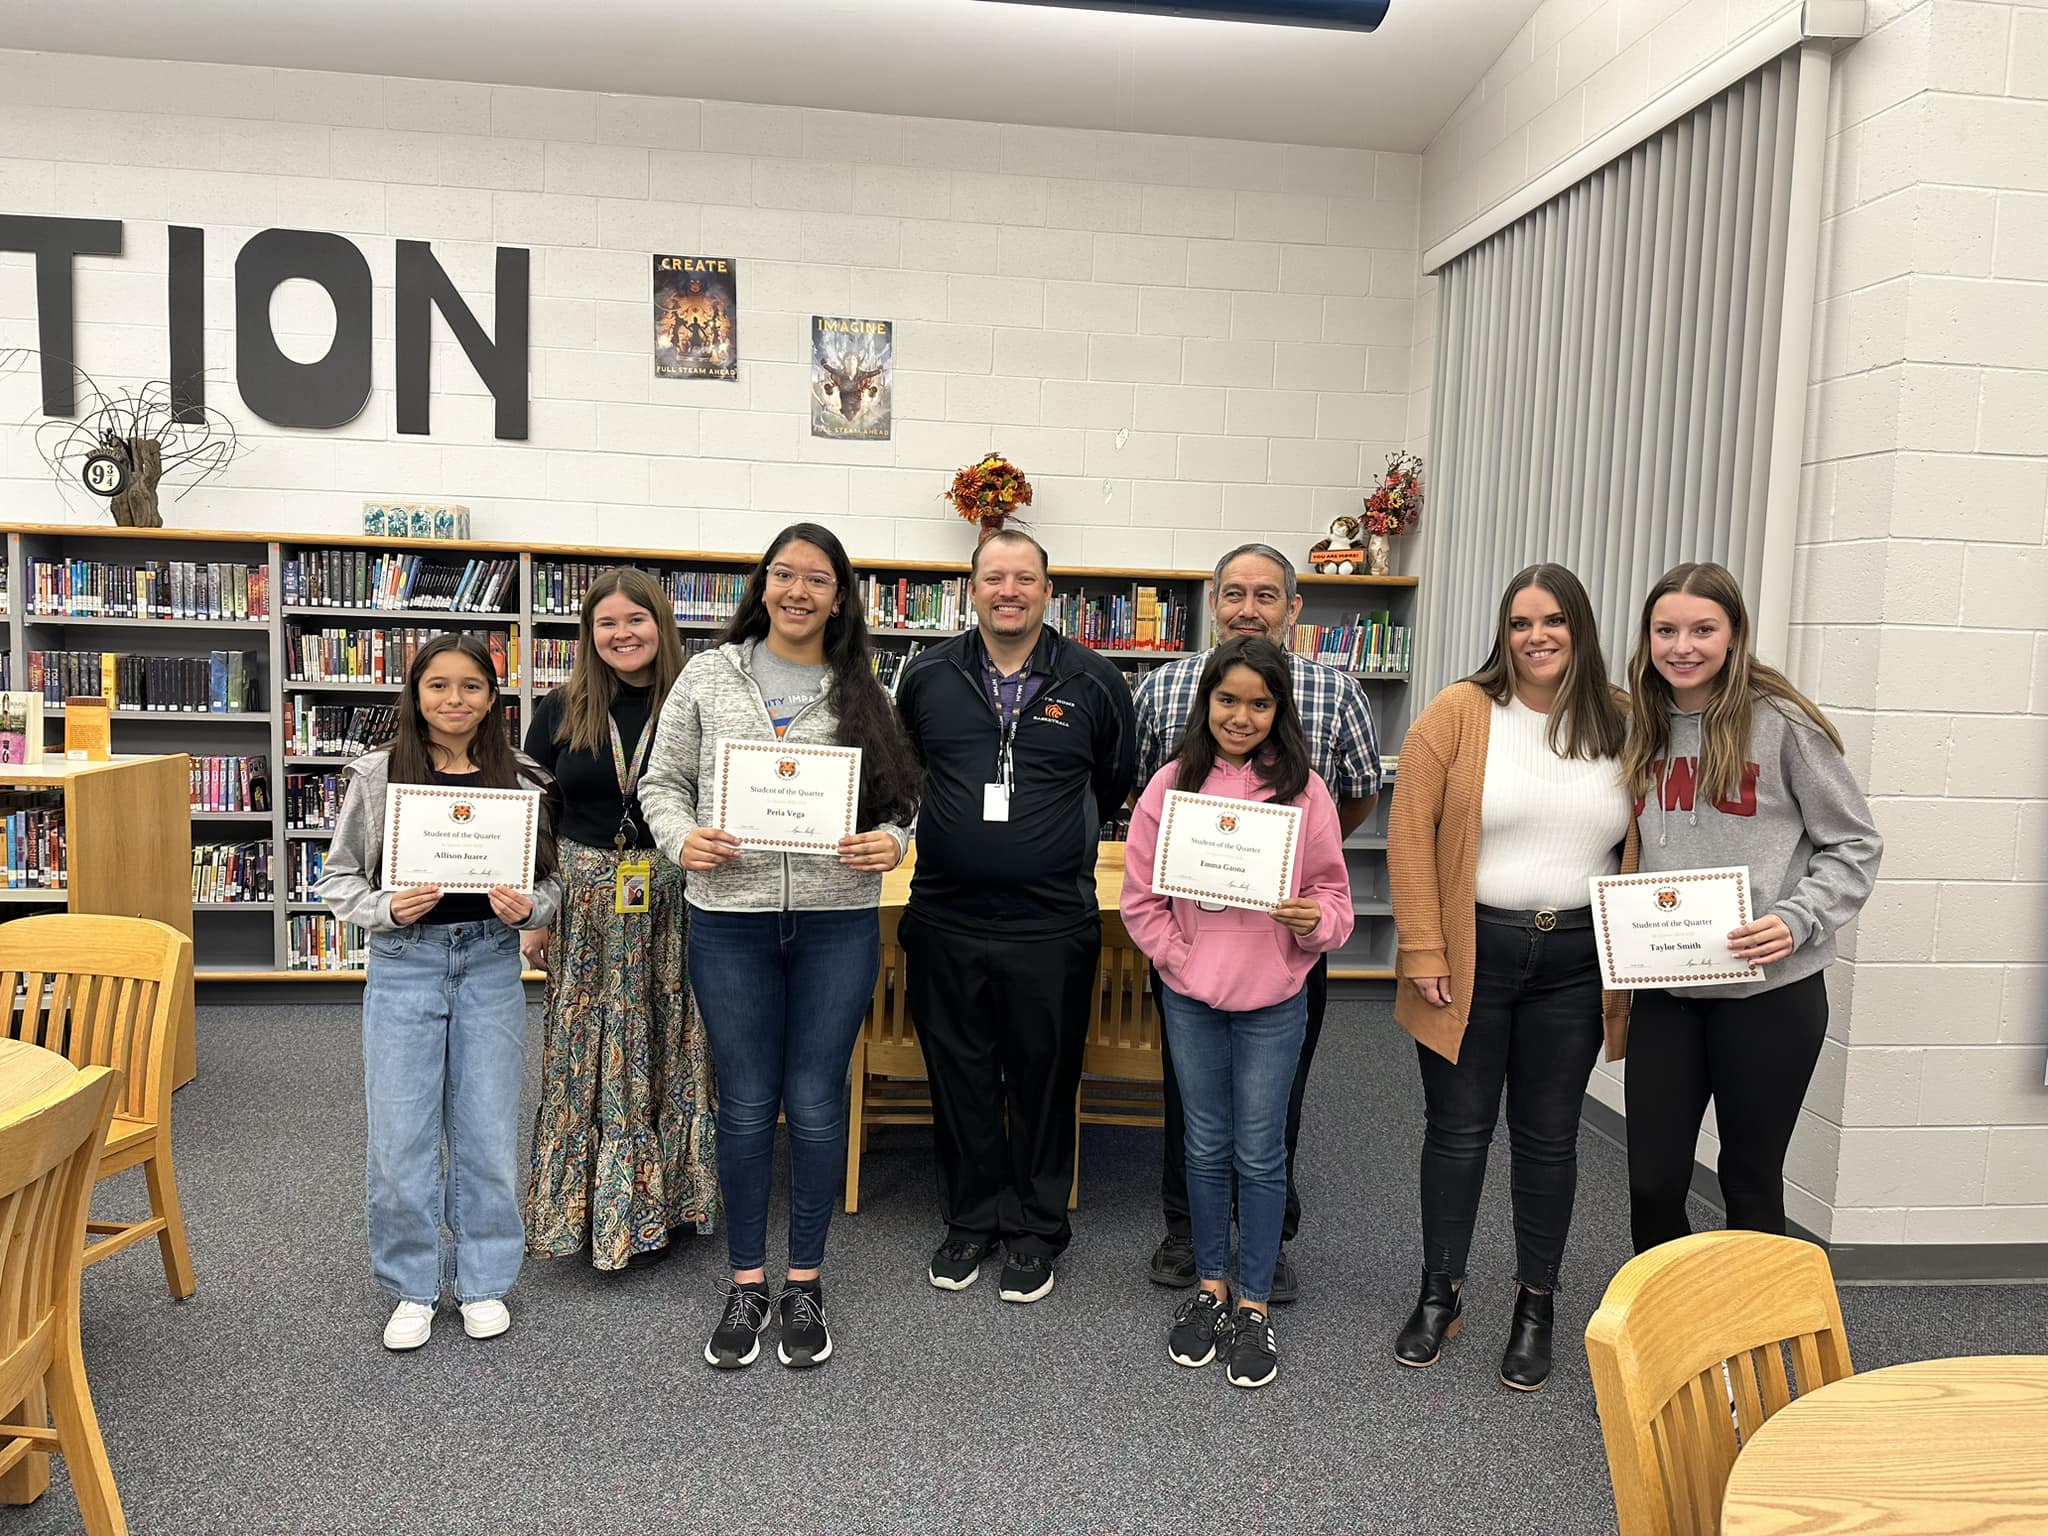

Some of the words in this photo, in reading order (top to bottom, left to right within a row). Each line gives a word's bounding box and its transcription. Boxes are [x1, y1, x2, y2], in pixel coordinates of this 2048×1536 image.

[661, 257, 728, 273] CREATE
[818, 319, 886, 335] IMAGINE
[656, 365, 677, 373] FULL
[678, 367, 706, 375] STEAM
[709, 368, 736, 376] AHEAD
[750, 785, 777, 795] Student
[777, 787, 785, 795] of
[786, 788, 797, 796] the
[798, 789, 825, 798] Quarter
[786, 809, 805, 819] Vega
[423, 830, 451, 839] Student
[452, 831, 460, 839] of
[473, 832, 501, 841] Quarter
[1191, 837, 1216, 847] Student
[1216, 840, 1224, 848] of
[1224, 841, 1235, 850] the
[1235, 843, 1261, 854] Quarter
[434, 851, 463, 860] Allison
[463, 852, 488, 861] Juarez
[1200, 859, 1222, 870] Emma
[1632, 921, 1660, 929] Student
[1661, 920, 1669, 928] of
[1684, 918, 1713, 927] Quarter
[1649, 943, 1675, 953] Taylor
[1676, 941, 1701, 951] Smith
